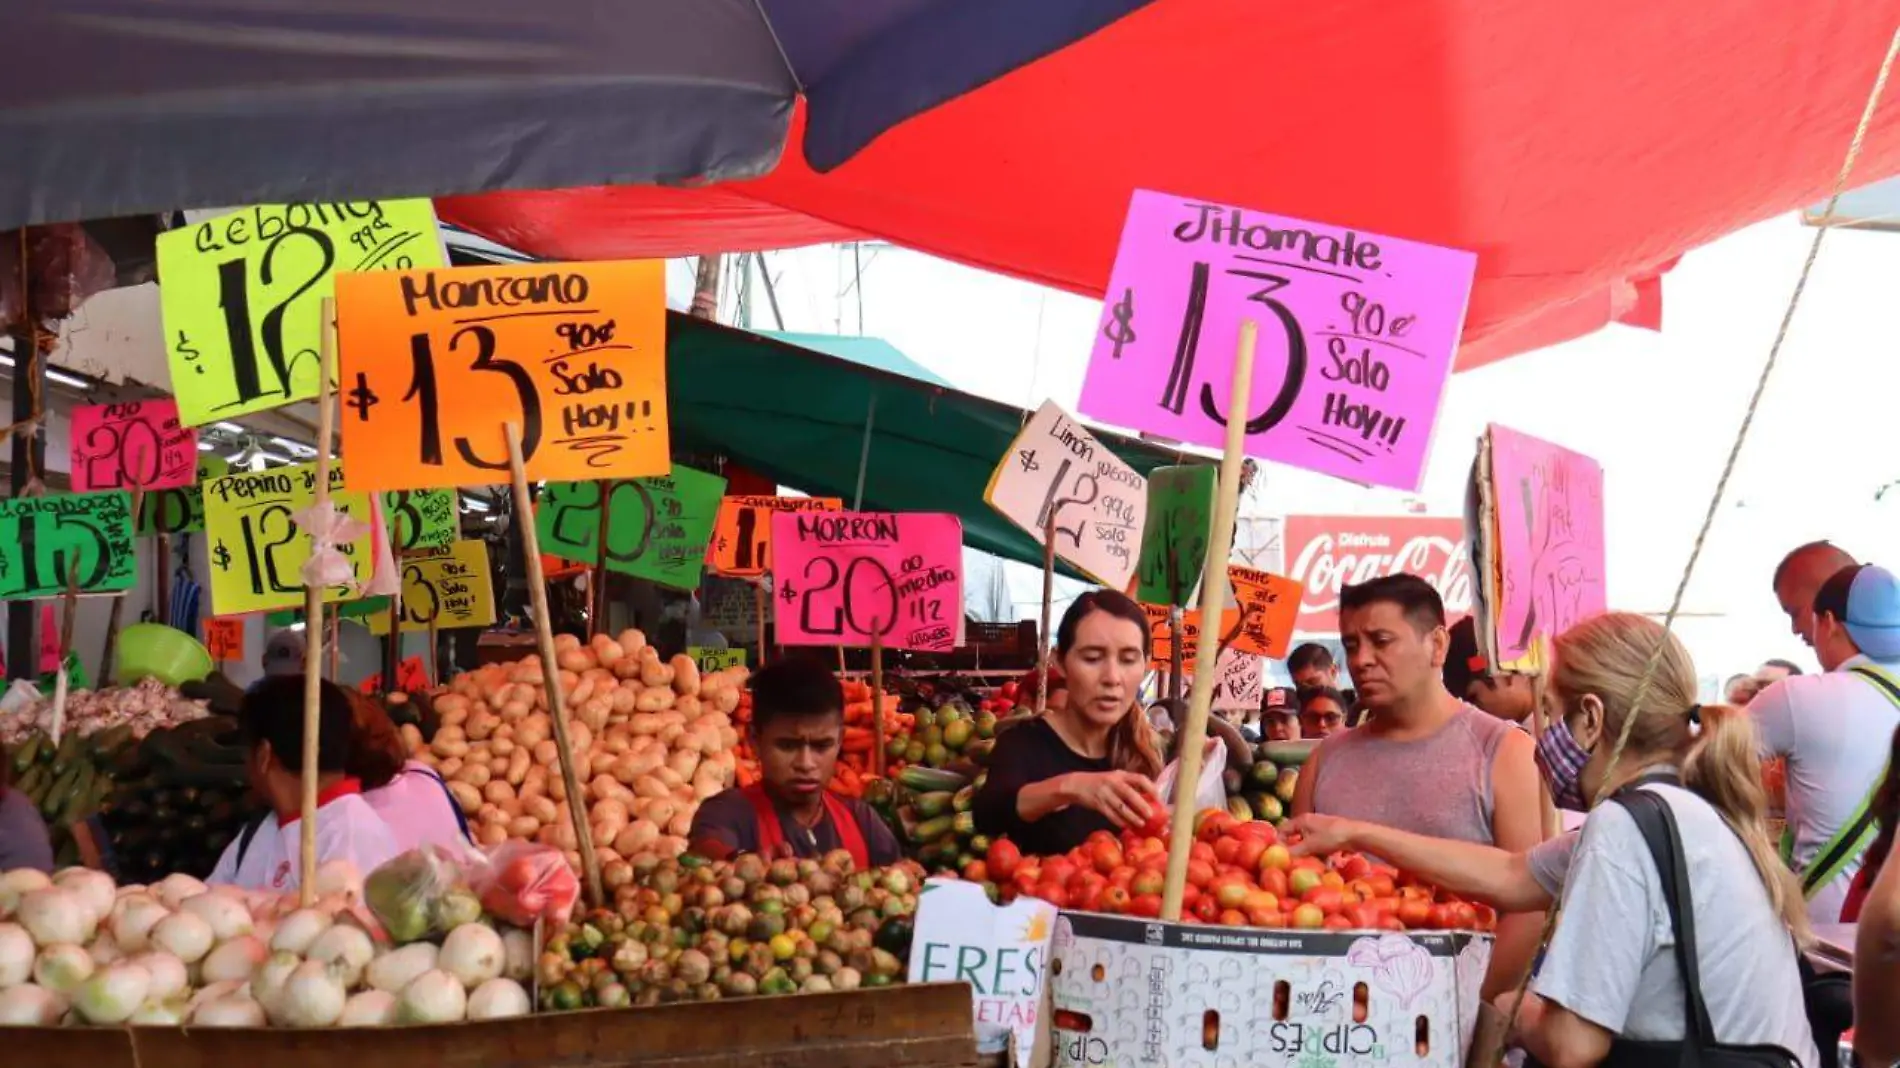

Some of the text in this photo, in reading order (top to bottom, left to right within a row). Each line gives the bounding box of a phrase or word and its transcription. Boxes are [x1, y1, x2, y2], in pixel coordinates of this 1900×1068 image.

[401, 272, 589, 317] Manzano
[550, 360, 623, 395] Solo
[1157, 261, 1307, 435] 13
[1320, 337, 1390, 392] Solo
[400, 324, 543, 470] 13
[86, 417, 162, 490] 20
[210, 475, 292, 502] Pepino
[551, 478, 655, 563] 20
[1035, 458, 1098, 549] 12
[16, 510, 111, 592] 15
[213, 537, 231, 572] $
[240, 505, 310, 595] 12
[735, 508, 770, 570] 1
[800, 555, 899, 637] 20
[921, 941, 1046, 996] FRES
[1297, 980, 1345, 1014] Ajos
[1270, 1022, 1377, 1058] CIPRÉS
